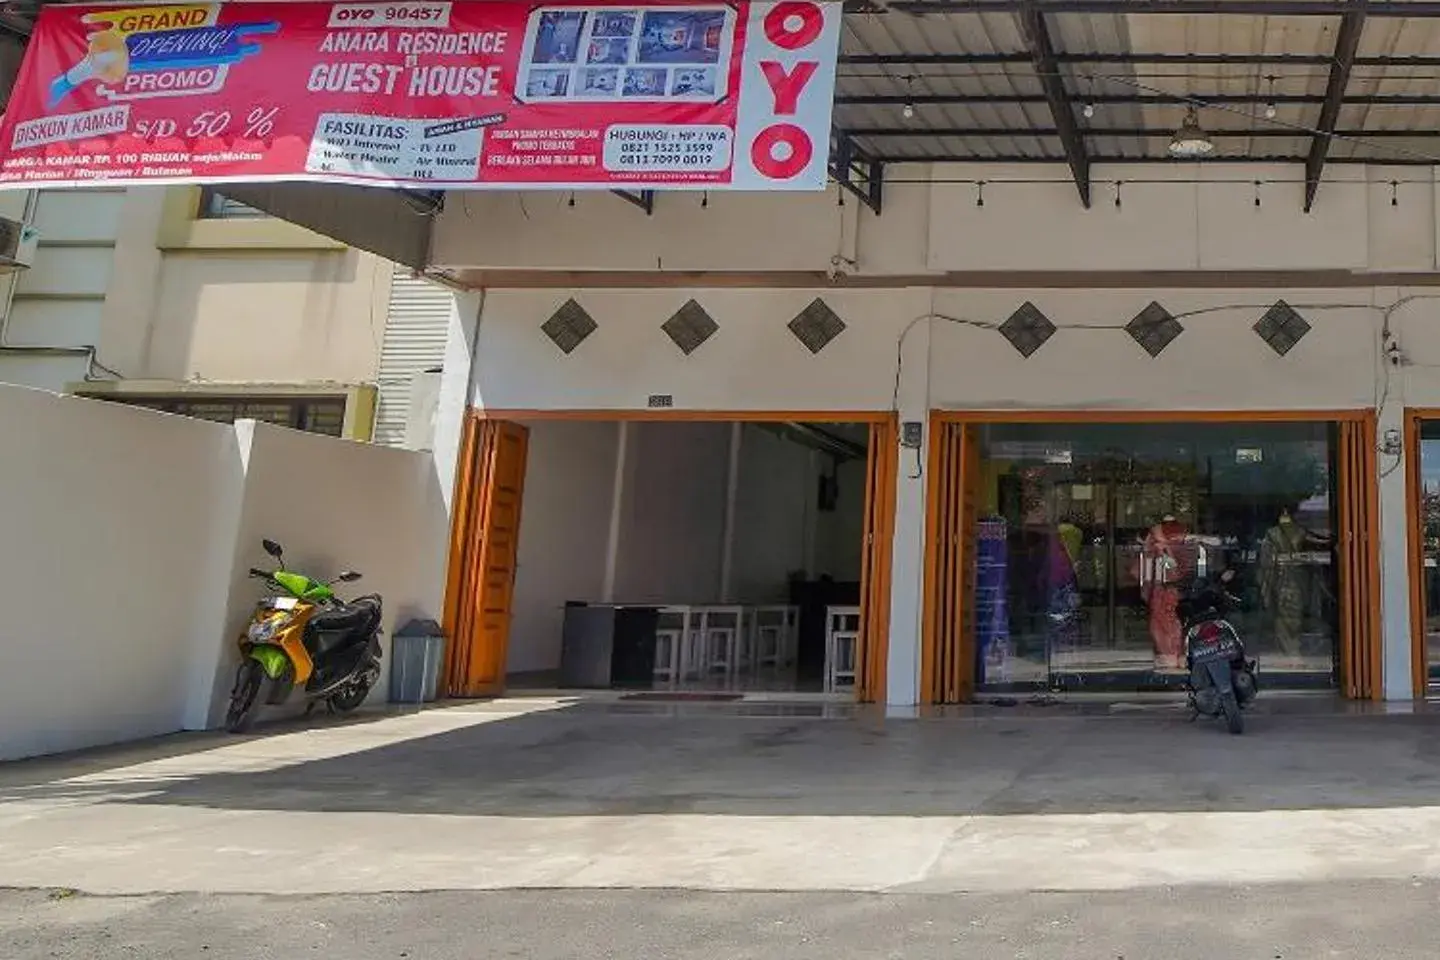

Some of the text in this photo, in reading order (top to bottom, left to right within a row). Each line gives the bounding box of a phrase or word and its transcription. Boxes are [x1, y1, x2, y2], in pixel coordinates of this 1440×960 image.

[120, 9, 208, 33] GRAND
[337, 7, 443, 20] OYO 90457
[319, 32, 508, 54] ANARA RESIDENCE
[125, 69, 214, 90] PROMO
[307, 63, 502, 97] GUEST HOUSE
[751, 1, 824, 179] OYO
[16, 111, 124, 142] DISKON KAMAR
[187, 112, 231, 136] 50
[244, 107, 280, 137] %
[610, 130, 668, 141] HUBUNGI
[46, 155, 91, 166] KAMAR
[116, 154, 138, 164] 100
